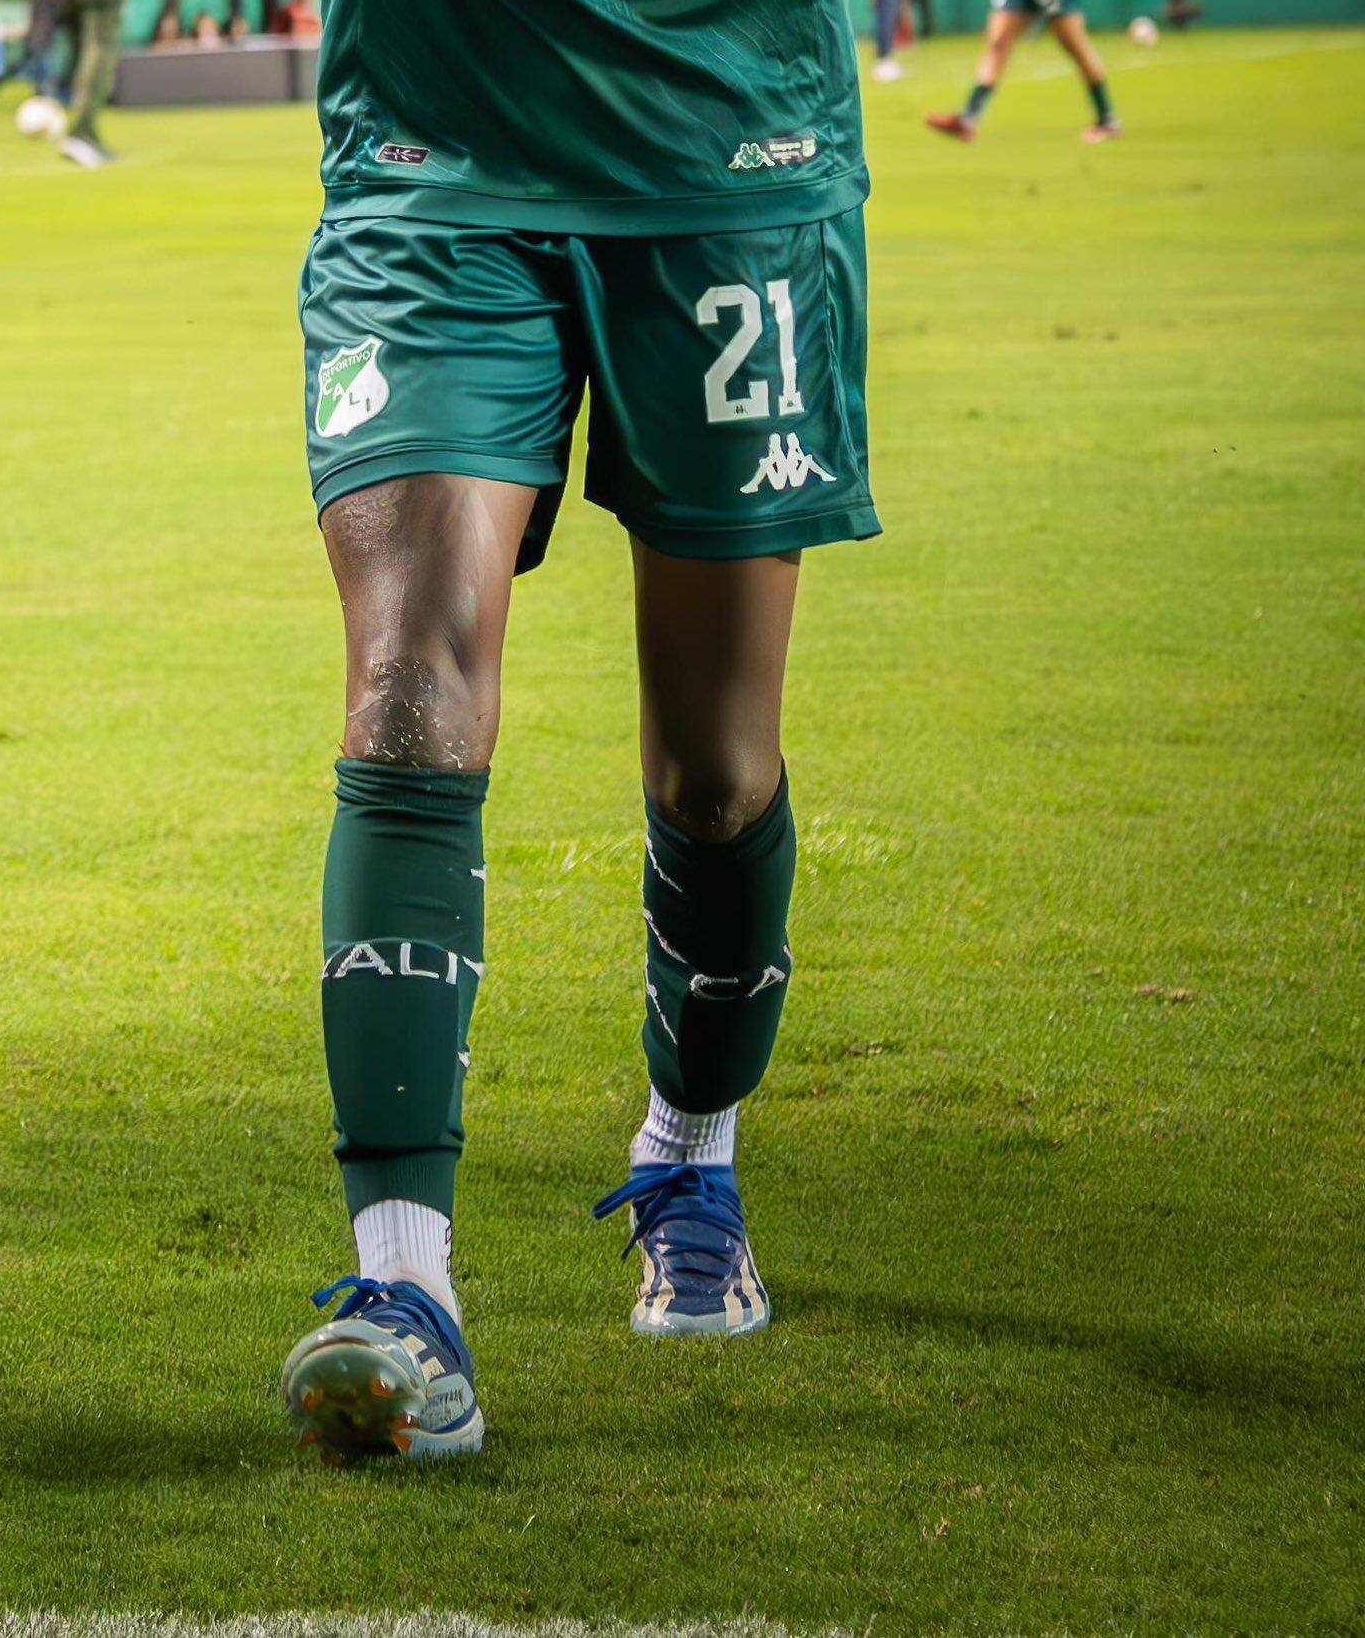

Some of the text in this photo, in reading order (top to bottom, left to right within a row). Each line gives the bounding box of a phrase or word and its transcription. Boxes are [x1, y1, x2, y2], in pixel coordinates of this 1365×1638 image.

[696, 279, 805, 424] 21
[322, 377, 372, 414] CALI
[324, 942, 458, 985] ALI
